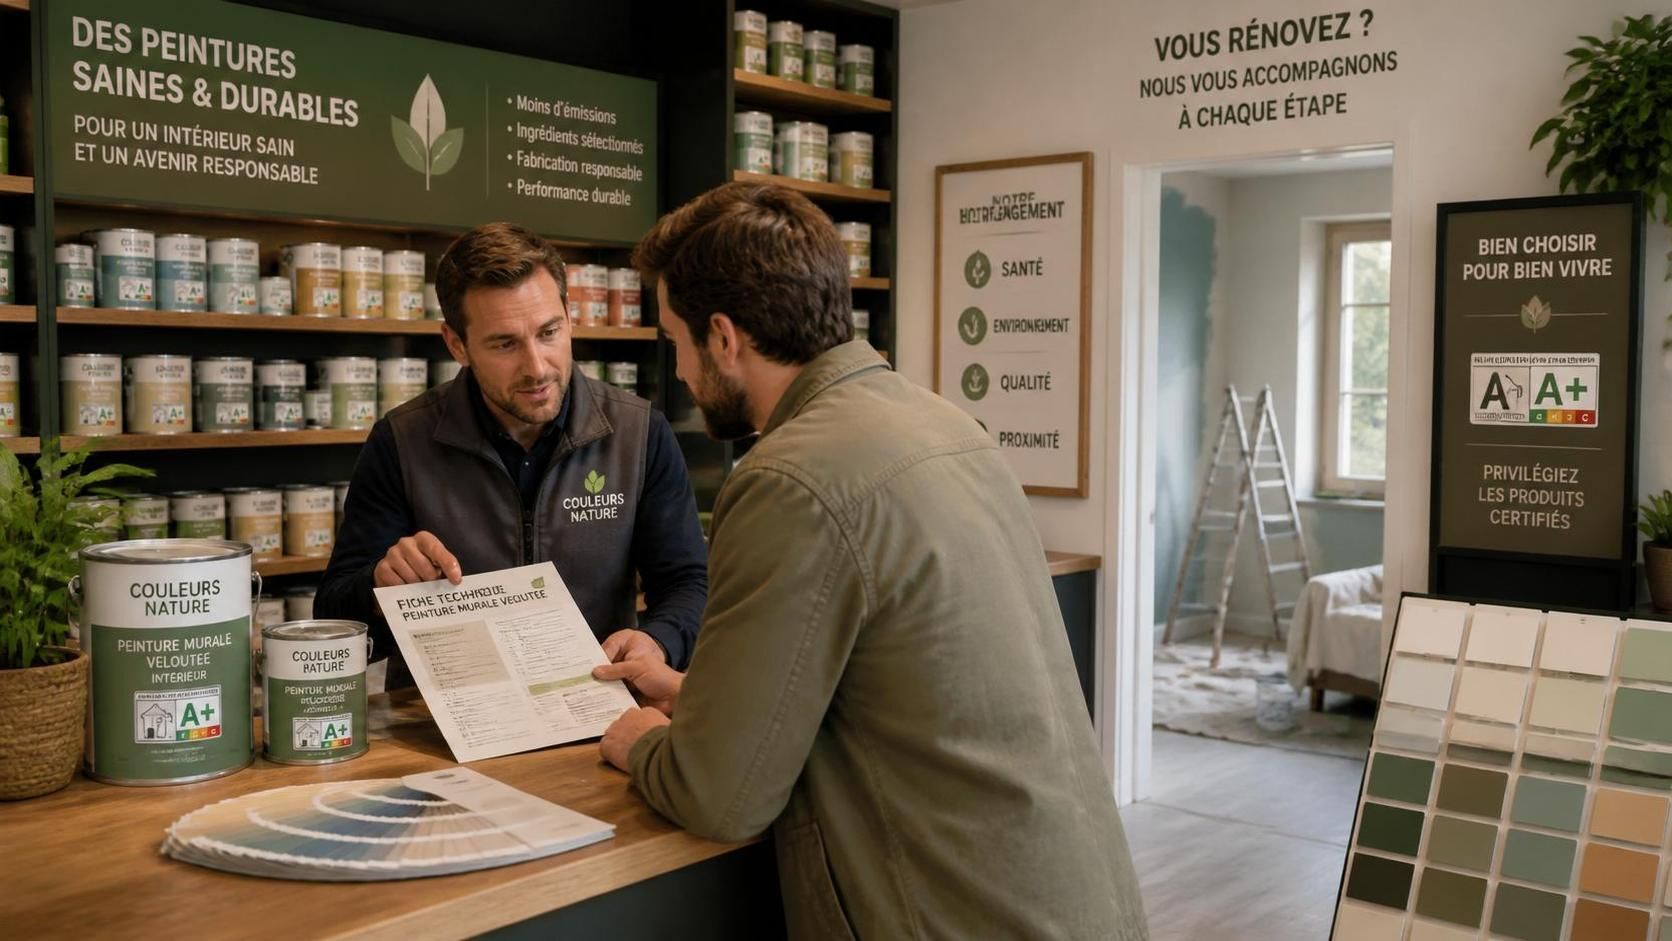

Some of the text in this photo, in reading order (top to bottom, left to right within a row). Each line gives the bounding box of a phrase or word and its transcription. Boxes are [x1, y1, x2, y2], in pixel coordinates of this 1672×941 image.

[1154, 9, 1374, 61] VOUS RÉNOVEZ ?
[72, 16, 296, 79] DES PEINTURES
[1140, 51, 1398, 98] NOUS VOUS ACCOMPAGNONS
[73, 60, 359, 127] SAINES & DURABLES
[517, 95, 617, 125] Moins d'émissions
[1178, 92, 1347, 129] À CHAQUE ÉTAPE
[74, 115, 295, 157] POUR UN INTÉRIEUR SAIN
[517, 122, 644, 155] Ingrédients sélectionnés
[75, 143, 318, 185] ET UN AVENIR RESPONSABLE
[517, 150, 643, 182] Fabrication responsable
[517, 179, 631, 206] Performance durable
[1479, 234, 1596, 255] BIEN CHOISIR
[1002, 257, 1043, 276] SANTÉ
[1463, 258, 1612, 280] POUR BIEN VIVRE
[1001, 371, 1051, 391] QUALITÉ
[1535, 373, 1588, 405] A+
[999, 429, 1060, 449] PROXIMITÉ
[1484, 463, 1579, 484] PRIVILÉGIEZ
[563, 493, 624, 509] COULEURS
[1479, 487, 1584, 507] LES PRODUITS
[571, 507, 618, 522] NATURE
[1490, 509, 1571, 529] CERTIFIÉS
[130, 580, 220, 598] COULEURS
[145, 599, 210, 616] NATURE
[396, 596, 434, 610] FICHE
[402, 603, 457, 621] PEINTURE
[457, 599, 499, 613] MURALE
[118, 633, 232, 652] PEINTURE MURALE
[292, 648, 350, 661] COULEURS
[180, 703, 215, 727] A+
[324, 723, 348, 740] A+
